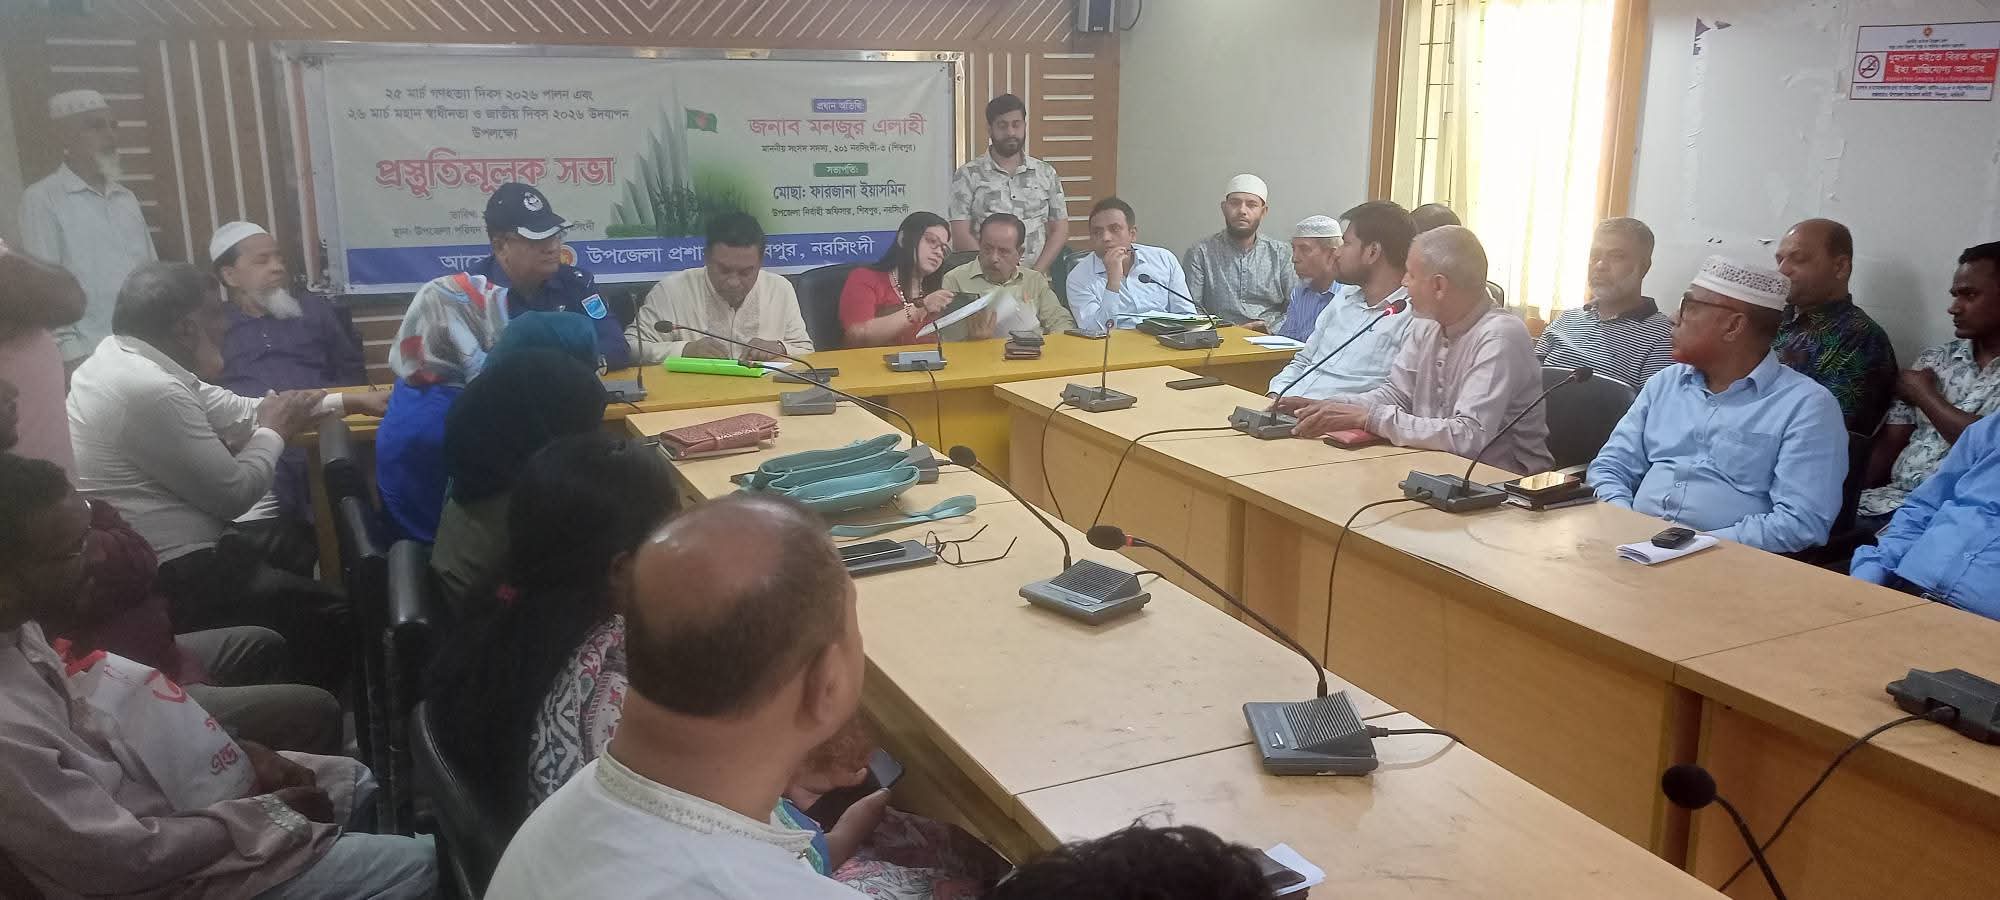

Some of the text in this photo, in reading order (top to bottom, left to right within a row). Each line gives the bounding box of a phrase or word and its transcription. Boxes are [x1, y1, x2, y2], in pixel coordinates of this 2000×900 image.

[385, 88, 402, 100] ২৫
[406, 85, 427, 99] মার্চ
[474, 86, 501, 99] দিবস
[506, 89, 538, 101] ২০২৬
[542, 88, 569, 100] পালন
[574, 89, 594, 101] এবং
[347, 108, 367, 120] ২৬
[370, 105, 390, 120] মার্চ
[394, 108, 422, 120] মহান
[426, 105, 468, 120] স্বাধীনতা
[473, 109, 482, 120] ও
[486, 105, 519, 120] জাতীয়
[522, 105, 549, 120] দিবস
[553, 109, 584, 121] ২০২৬
[748, 112, 927, 140] জনাব মনজুর এলাহী
[376, 147, 616, 200] প্রস্তুতিমূলক সভা
[808, 183, 857, 200] ফারজানা
[859, 179, 907, 199] ইয়াসমিন
[585, 245, 664, 264] উপজেলা
[810, 235, 876, 257] নরসিংদী
